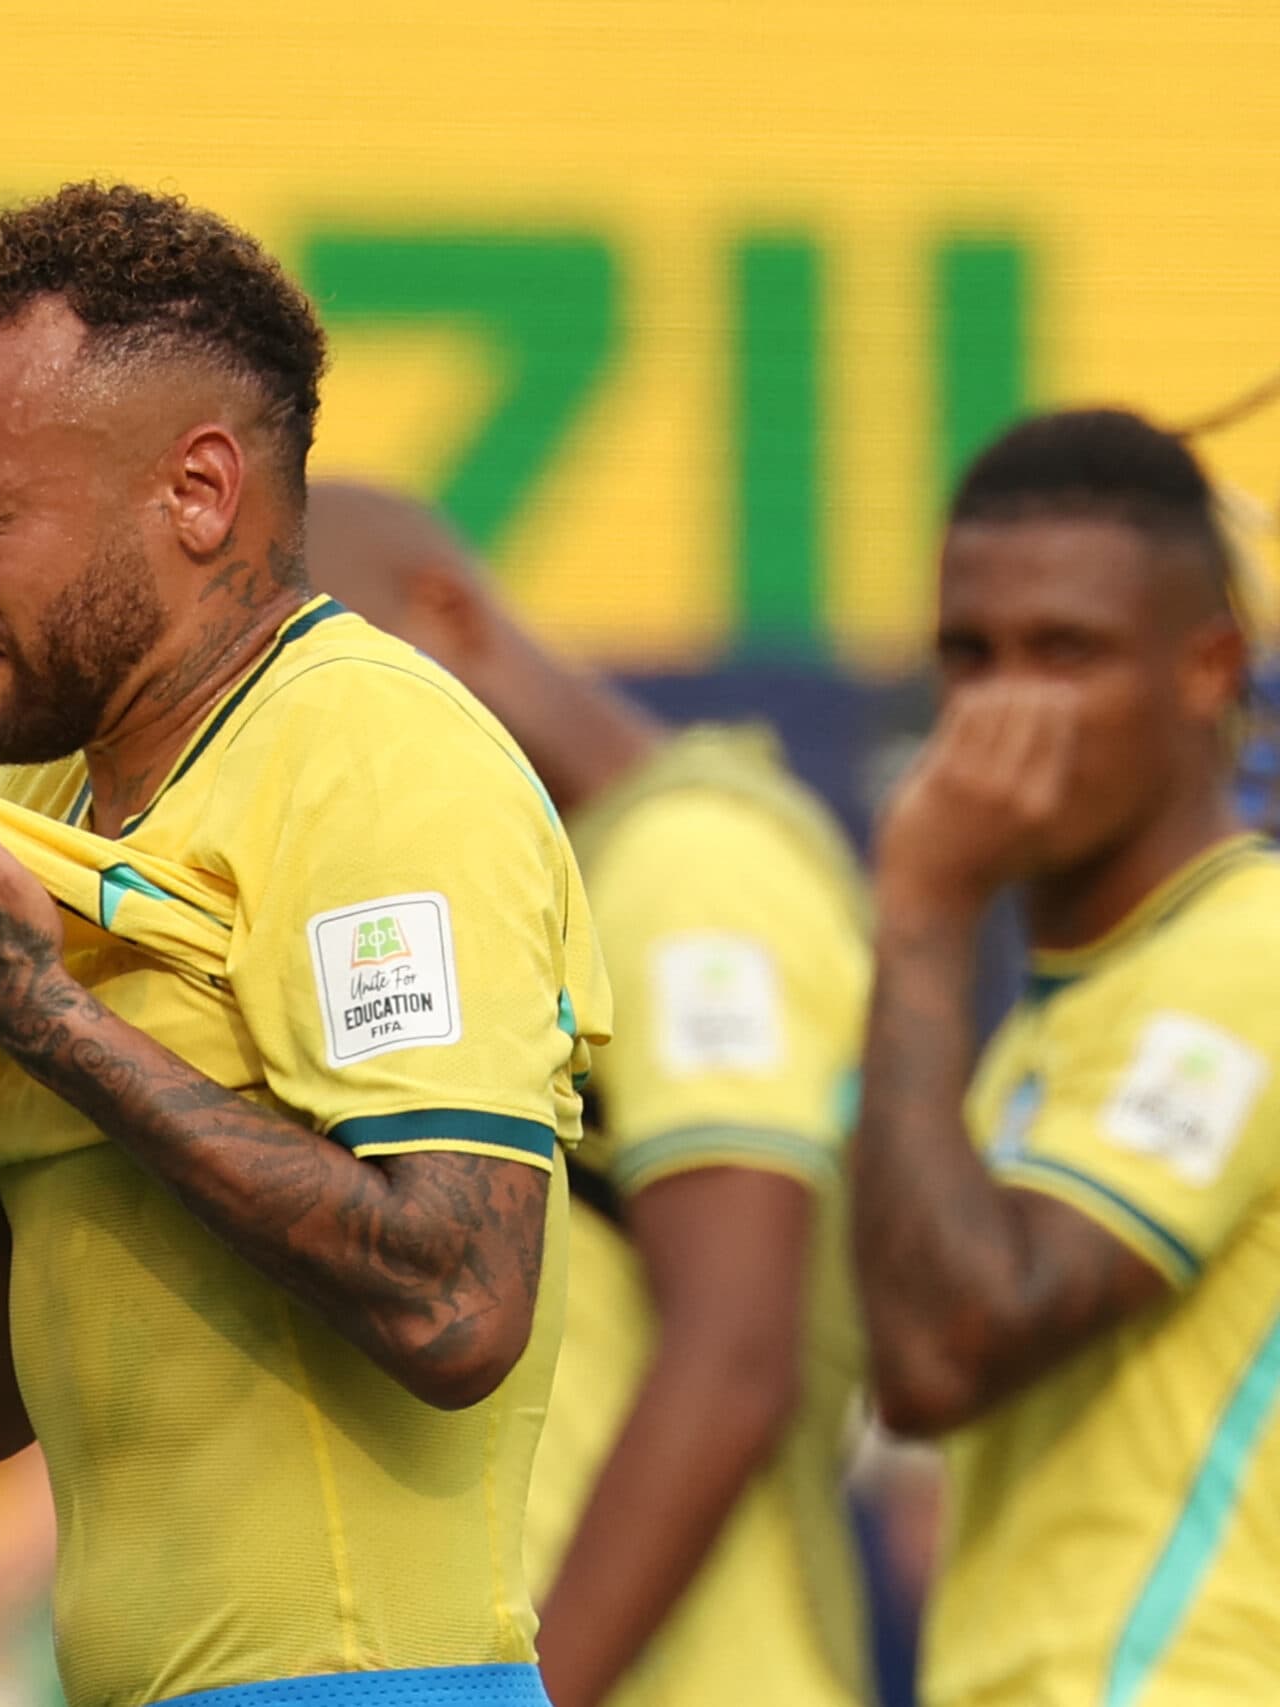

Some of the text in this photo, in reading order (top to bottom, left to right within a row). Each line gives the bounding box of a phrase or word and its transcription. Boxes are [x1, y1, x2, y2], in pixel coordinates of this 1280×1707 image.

[351, 965, 417, 1000] Unite For
[344, 993, 433, 1030] EDUCATION
[371, 1021, 402, 1038] FIFA
